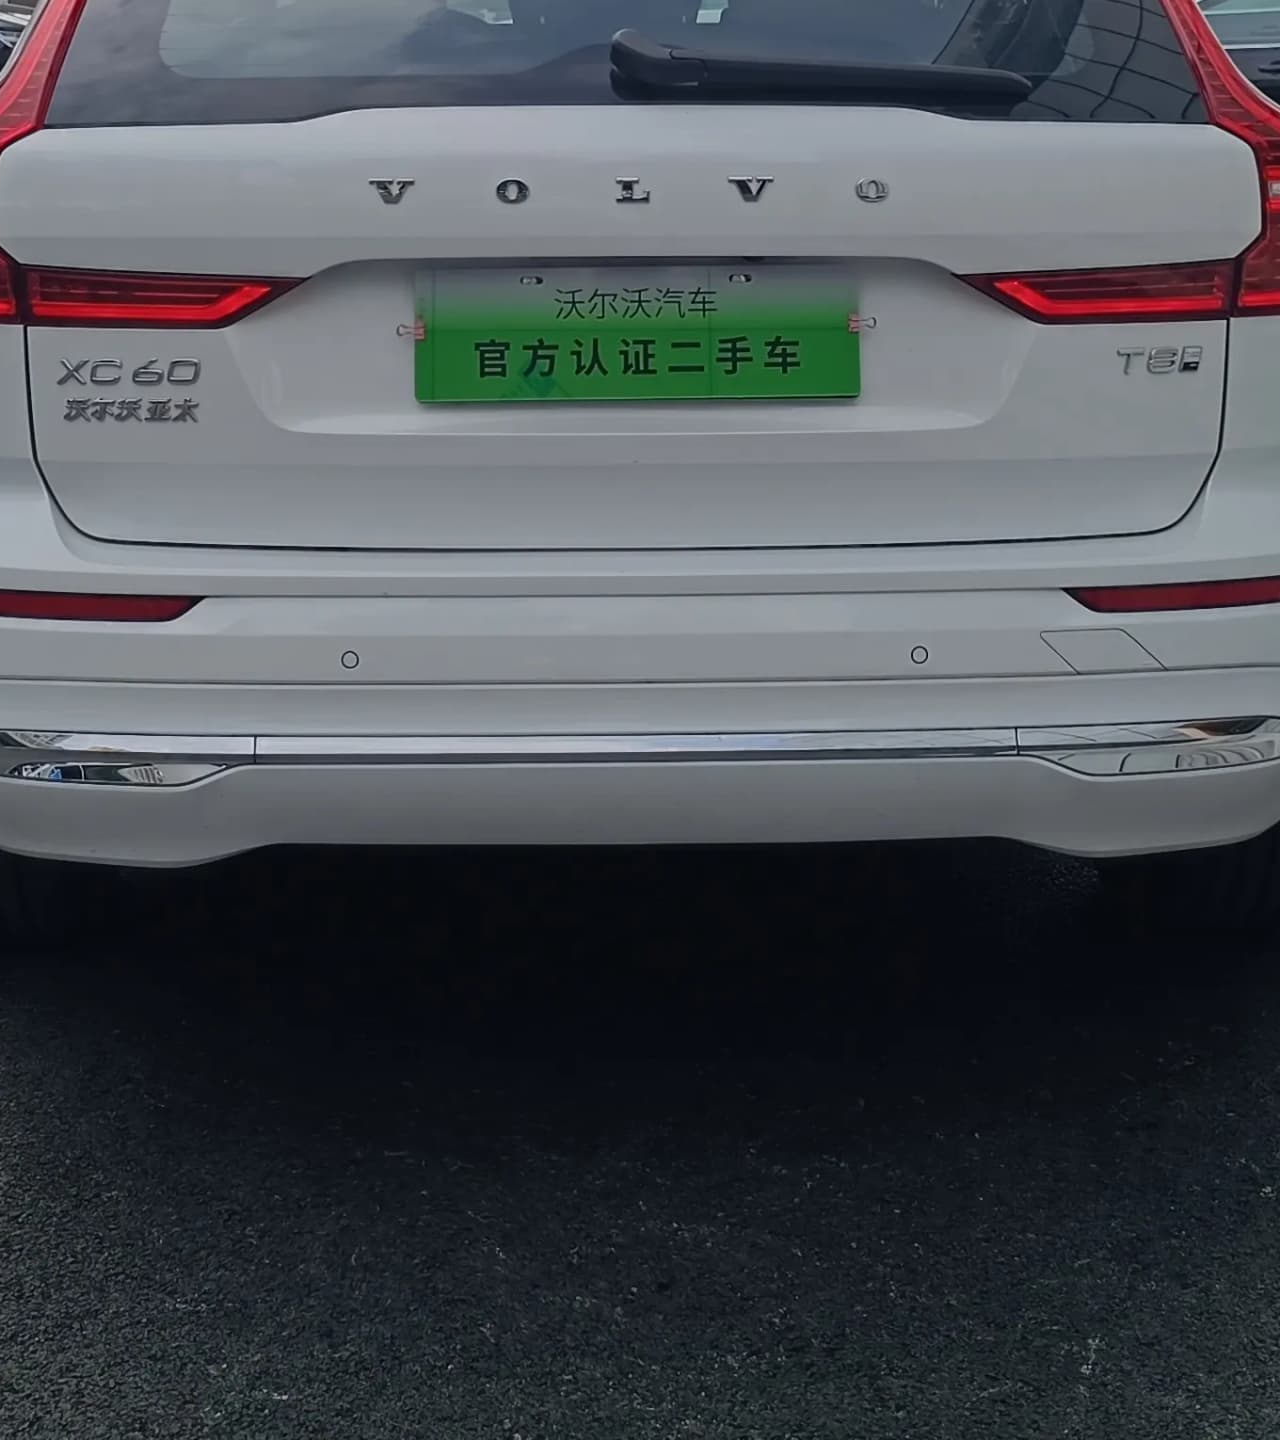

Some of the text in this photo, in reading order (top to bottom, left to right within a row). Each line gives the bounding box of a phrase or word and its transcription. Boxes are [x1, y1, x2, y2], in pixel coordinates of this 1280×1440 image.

[368, 175, 890, 204] VOLVO
[553, 286, 718, 321] 沃尔沃汽车
[473, 336, 802, 379] 官方认证二手车
[63, 397, 200, 423] 沃尔沃亚太
